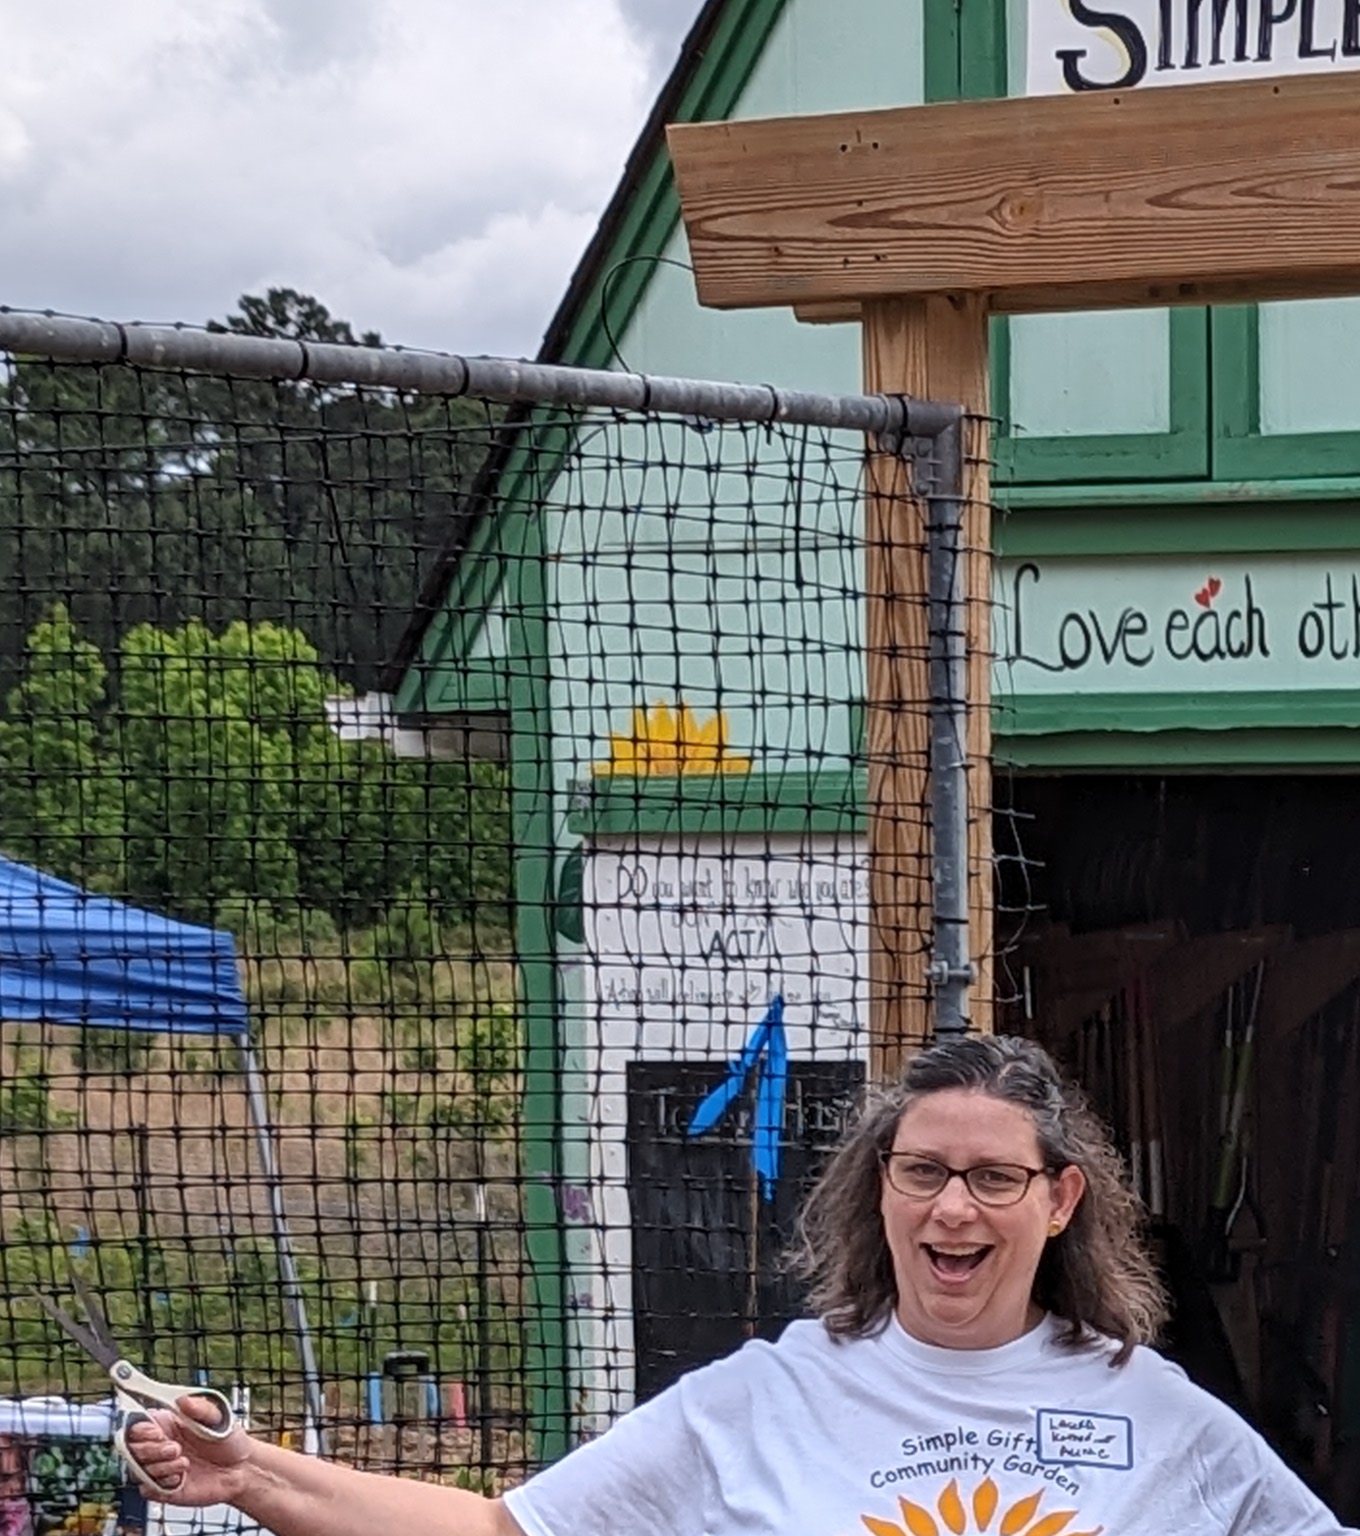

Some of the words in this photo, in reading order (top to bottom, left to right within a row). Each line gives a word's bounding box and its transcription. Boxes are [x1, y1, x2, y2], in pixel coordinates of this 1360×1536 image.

[1012, 562, 1154, 672] Love
[1165, 572, 1270, 662] each
[902, 1426, 979, 1456] Simple
[987, 1429, 1038, 1455] Gift
[870, 1452, 995, 1489] Community
[1003, 1454, 1080, 1496] Garden
